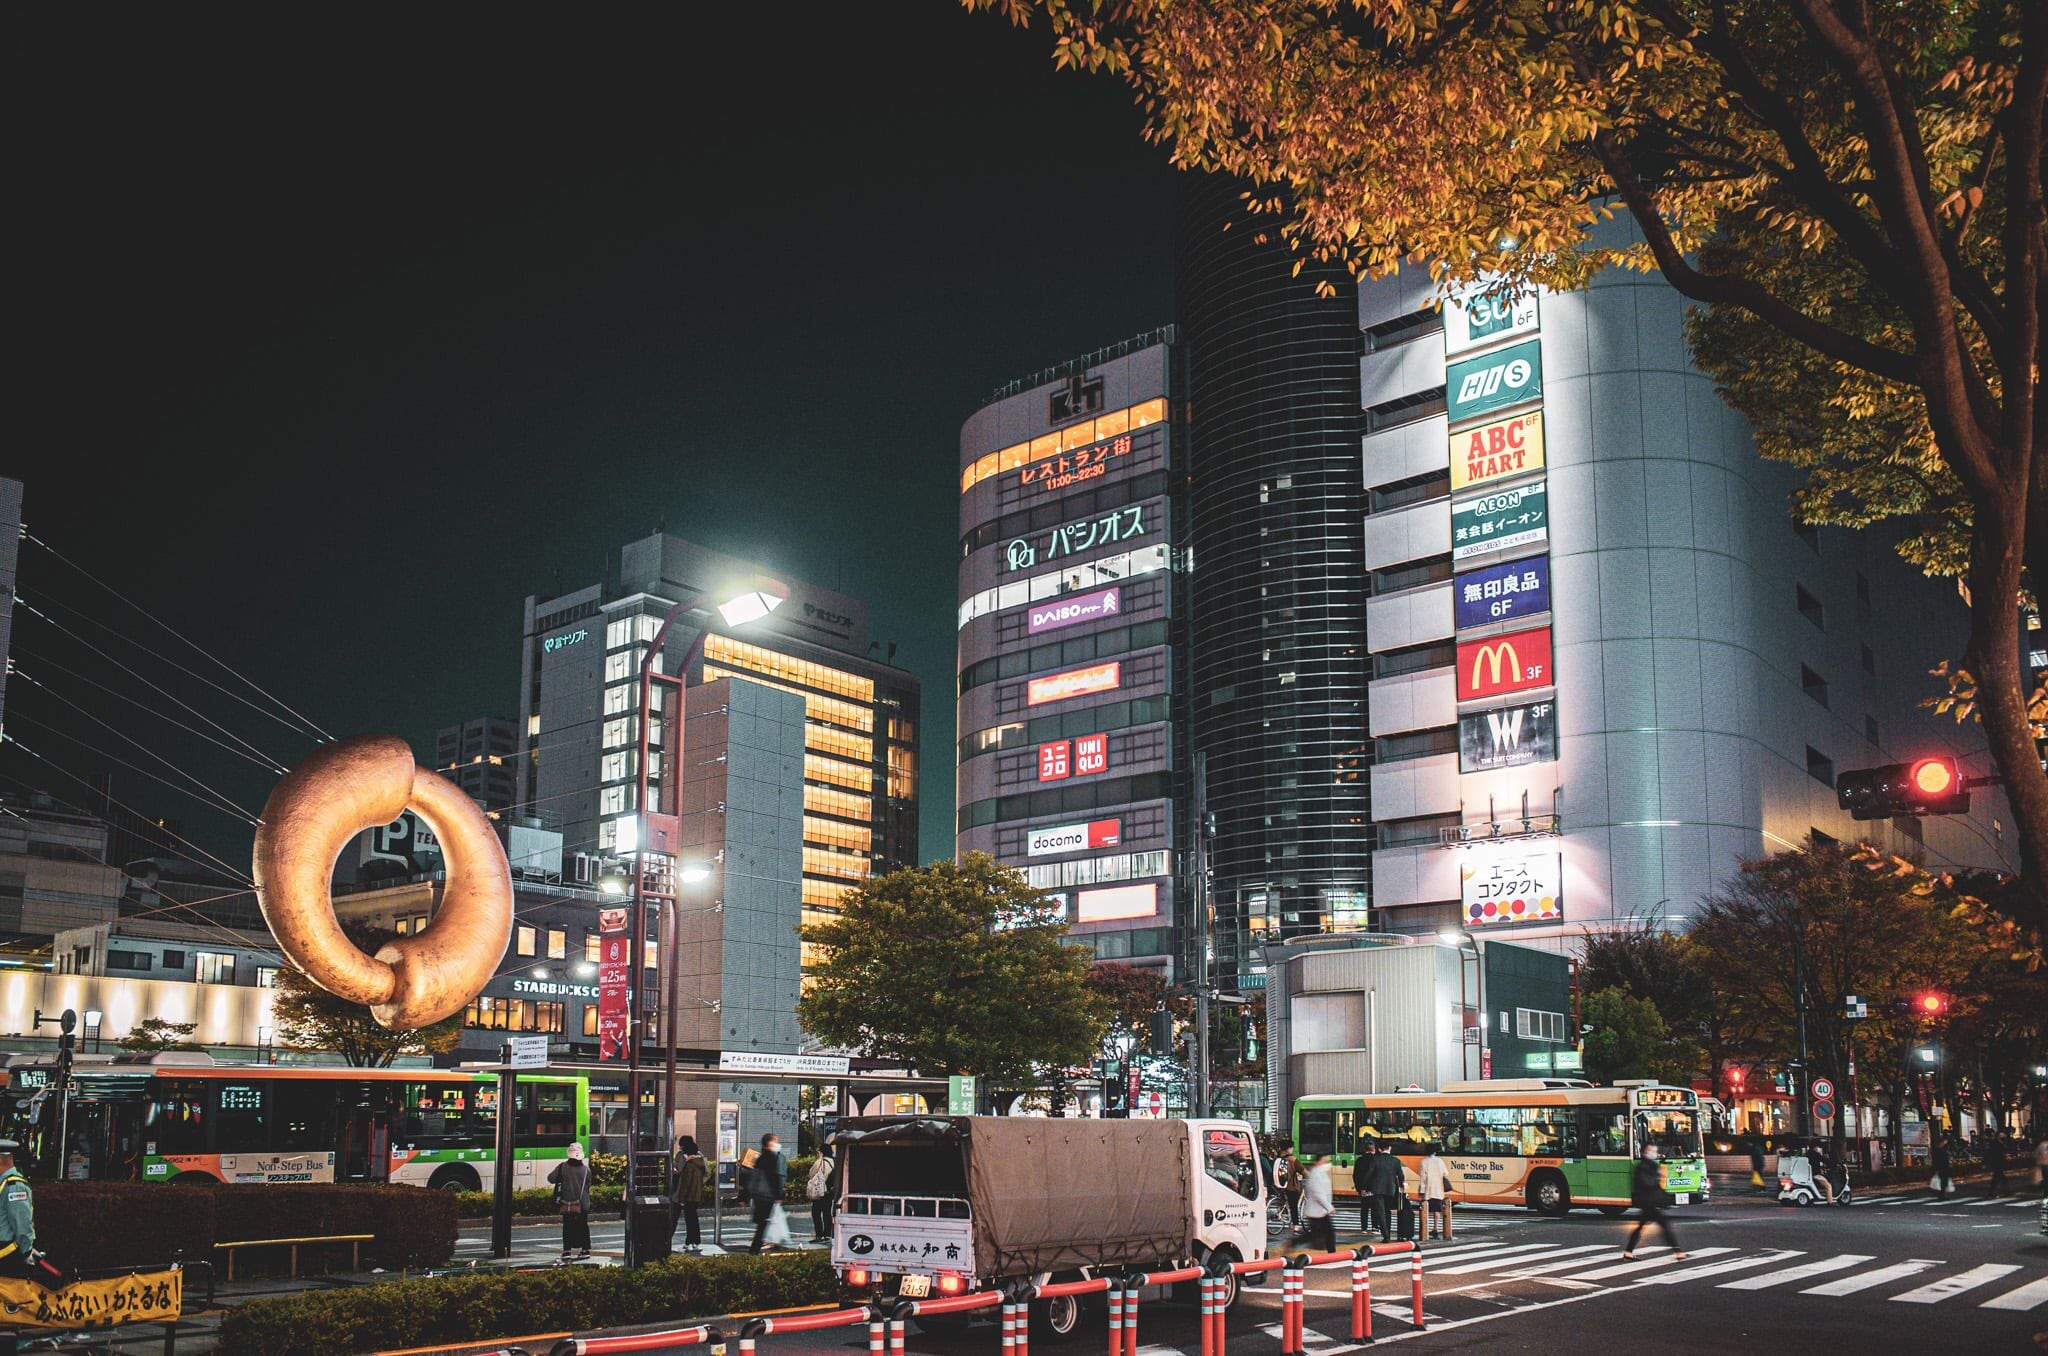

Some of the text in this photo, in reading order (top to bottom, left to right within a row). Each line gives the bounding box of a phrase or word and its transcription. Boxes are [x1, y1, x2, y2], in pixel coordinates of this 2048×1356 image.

[1471, 300, 1533, 327] GU 6F
[1467, 414, 1538, 461] ABC 6F
[1021, 436, 1133, 485] レストラン街
[1467, 449, 1525, 481] MART
[1476, 491, 1520, 515] AEON
[1048, 506, 1144, 559] パシオス
[1456, 511, 1542, 541] 英会話イーオン
[1463, 571, 1539, 603] 無印良品
[1491, 599, 1512, 617] 6F
[1526, 665, 1543, 680] 3F
[1532, 704, 1549, 718] 3F
[1079, 739, 1101, 755] UNI
[1079, 755, 1104, 772] QLO
[1505, 752, 1533, 762] COMPANY
[1033, 833, 1083, 849] docomo
[1491, 863, 1528, 880] エース
[1478, 879, 1544, 899] コンタクト
[513, 980, 589, 998] STARBUCKS
[1817, 1084, 1829, 1094] 40
[306, 1160, 323, 1170] Bus
[1490, 1162, 1504, 1171] Bus
